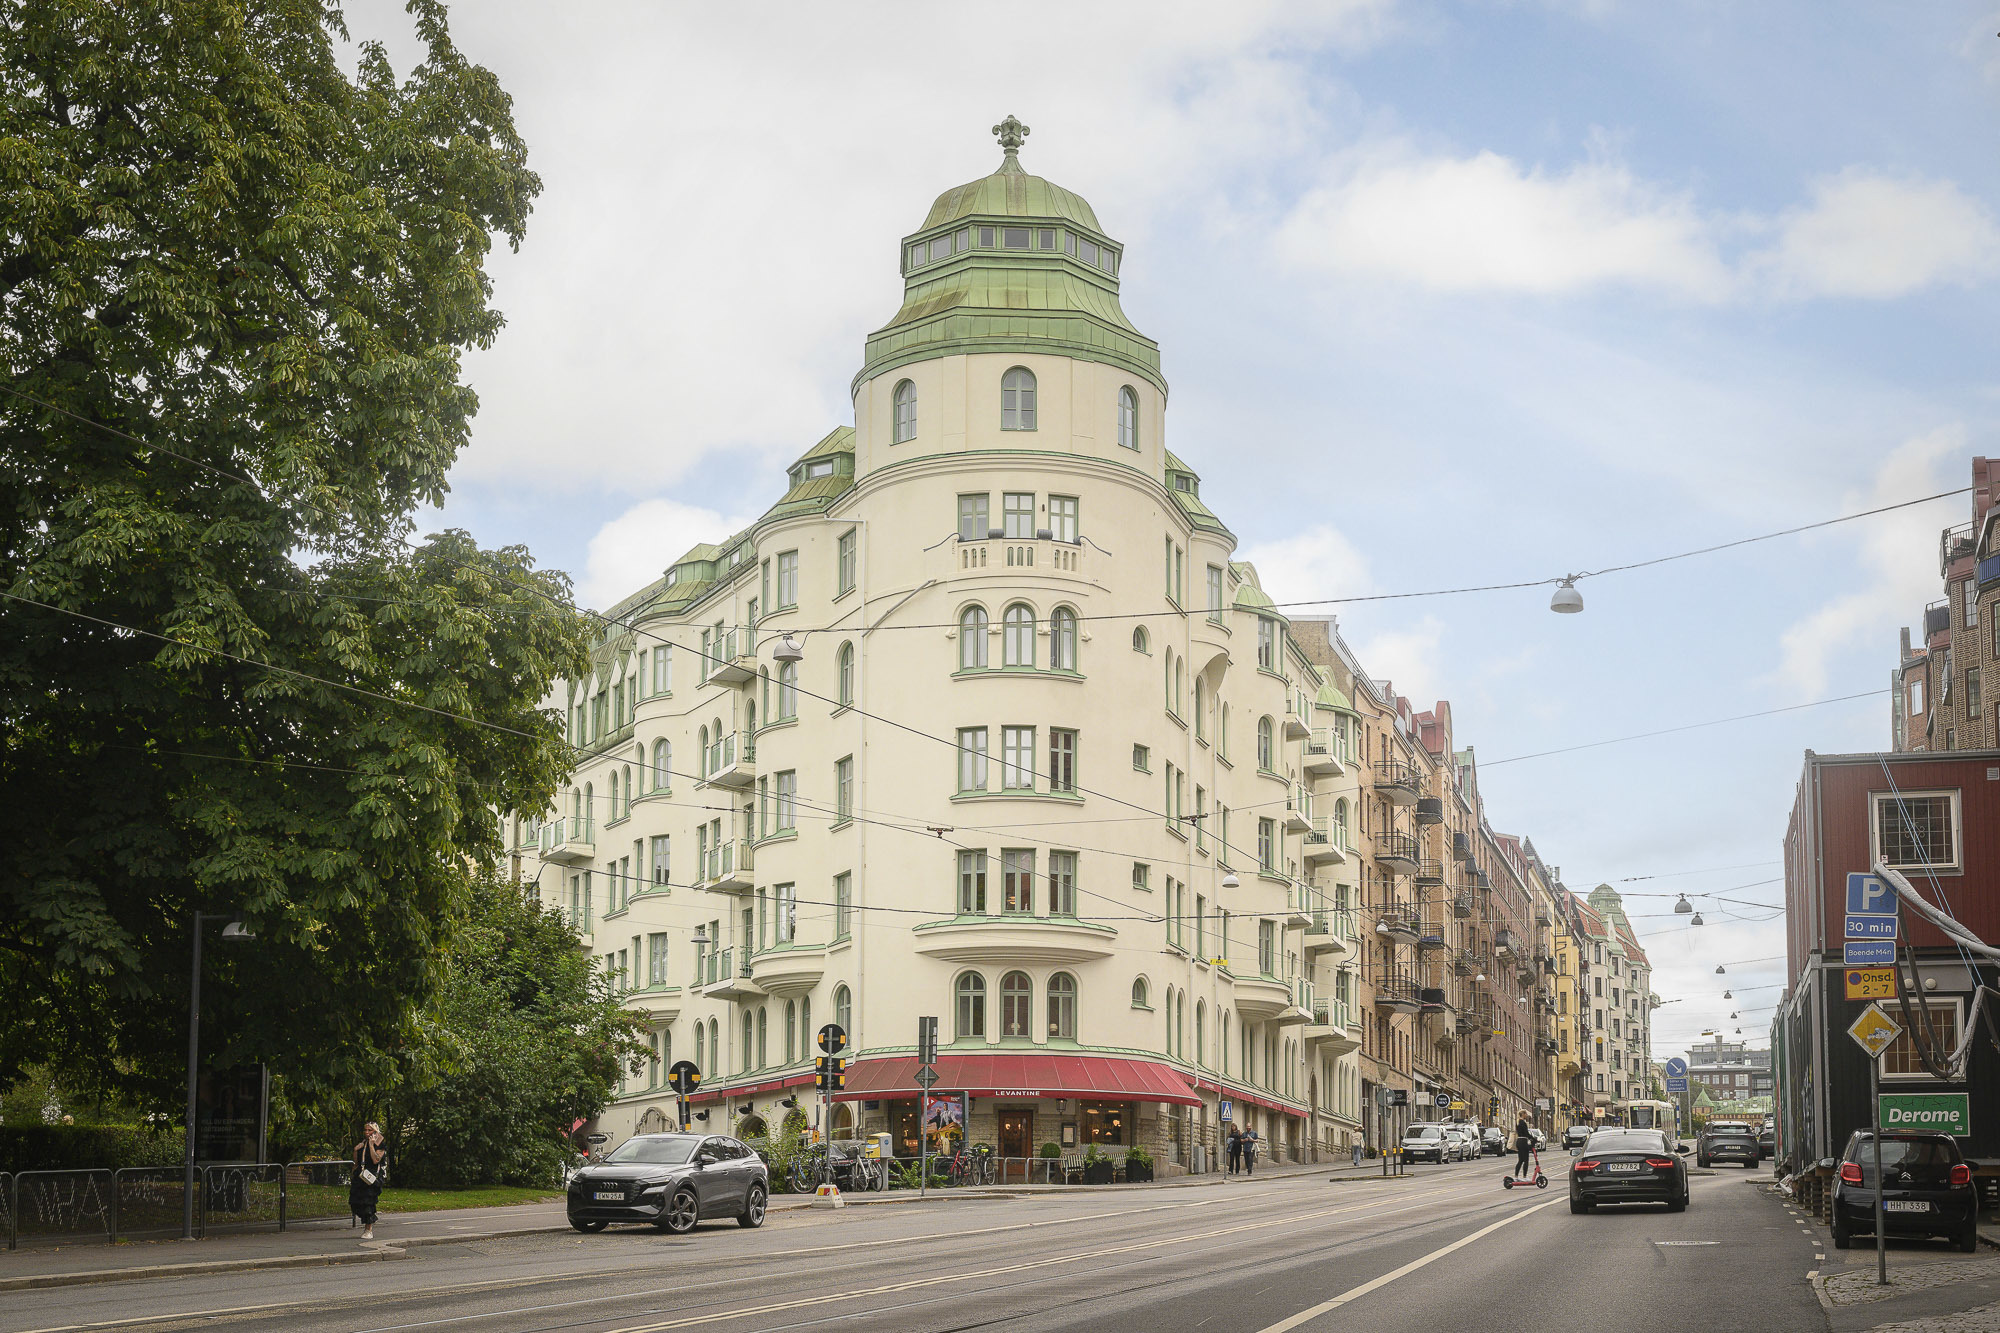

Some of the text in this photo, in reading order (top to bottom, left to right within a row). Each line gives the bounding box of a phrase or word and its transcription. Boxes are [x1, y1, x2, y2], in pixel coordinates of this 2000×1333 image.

[1862, 877, 1887, 910] P
[1848, 922, 1892, 933] 30 min
[1862, 972, 1894, 983] Onsd.
[1863, 985, 1870, 994] 2
[1881, 984, 1889, 994] 7
[1888, 1108, 1960, 1123] Derome
[1890, 1201, 1927, 1210] HHT 338
